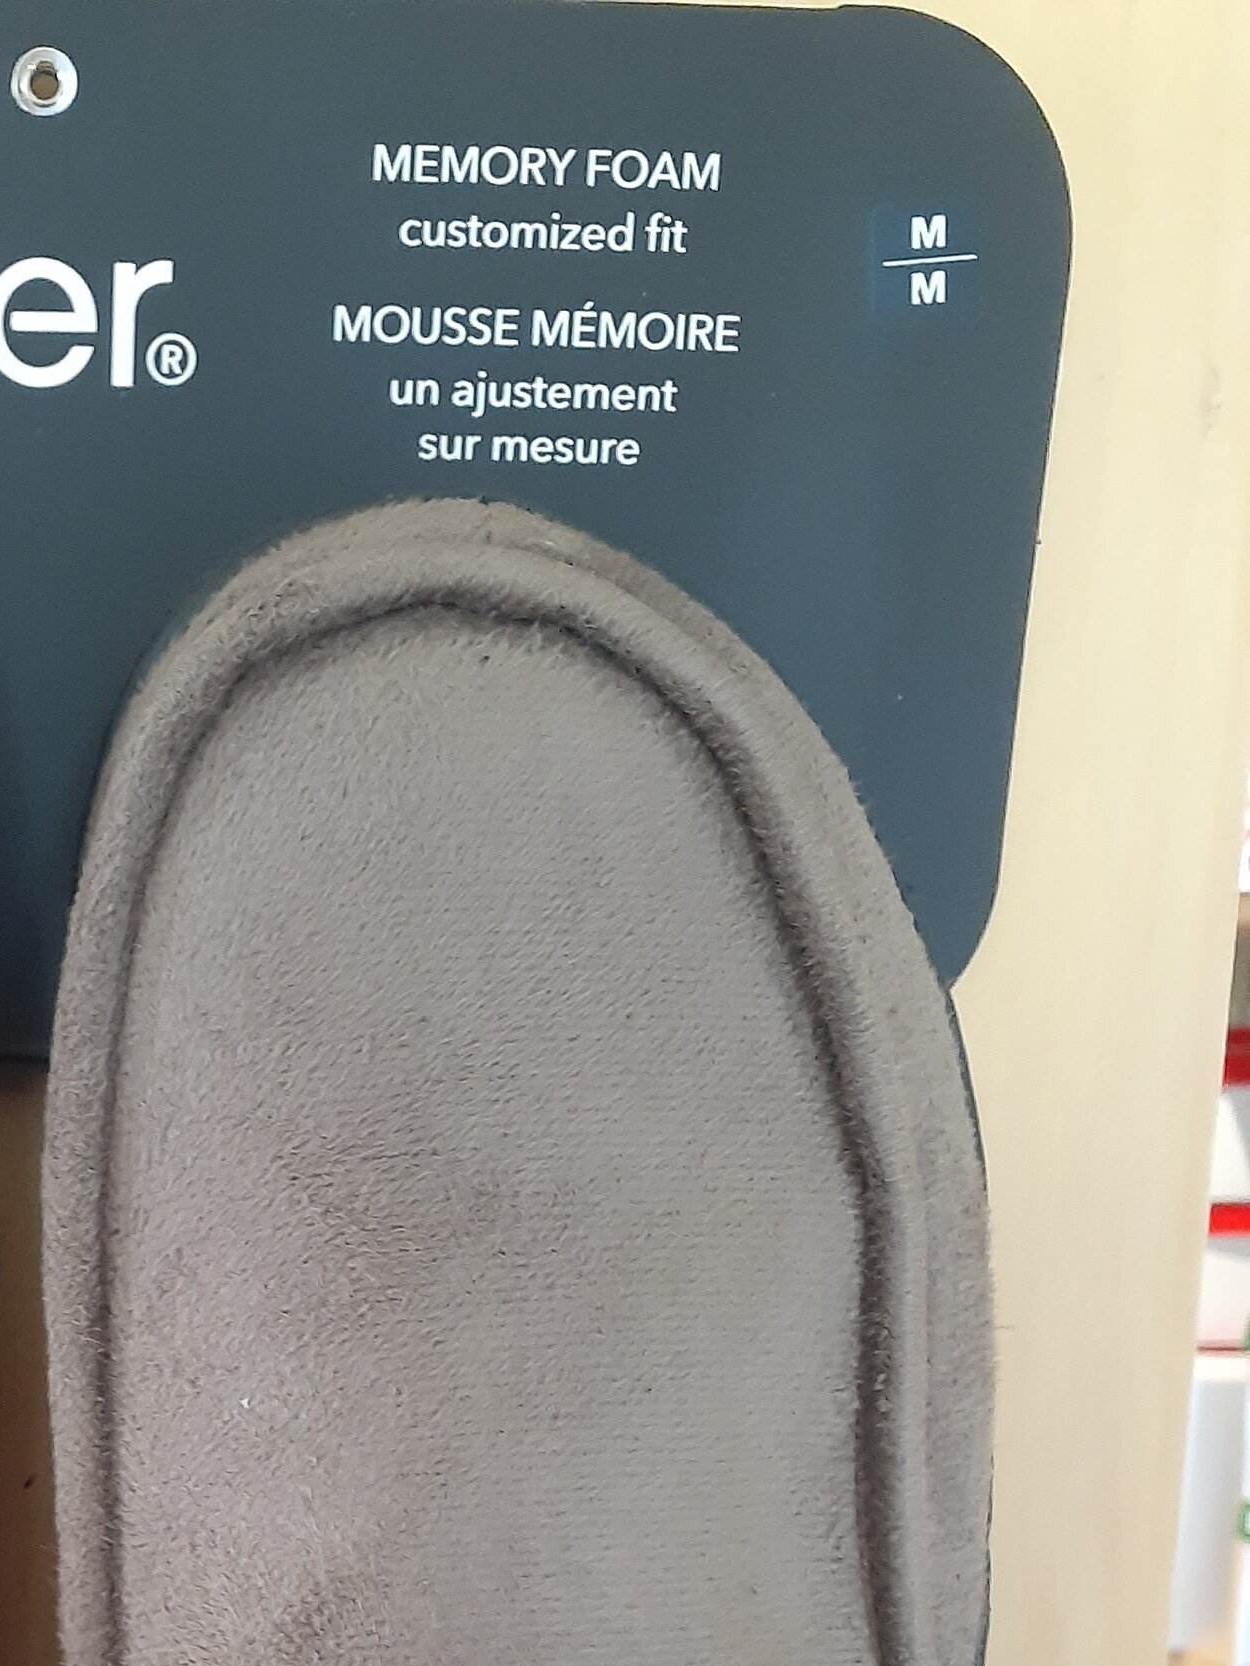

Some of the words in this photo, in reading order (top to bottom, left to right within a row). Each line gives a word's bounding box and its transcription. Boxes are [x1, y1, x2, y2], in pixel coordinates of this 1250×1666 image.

[372, 143, 576, 187] MEMORY
[585, 148, 722, 192] FOAM
[398, 211, 636, 253] customized
[643, 211, 690, 255] fit
[909, 213, 948, 251] M
[909, 269, 947, 307] M
[333, 304, 521, 348] MOUSSE
[530, 300, 742, 353] MÉMOIRE
[388, 378, 441, 407] un
[450, 370, 680, 420] ajustement
[416, 432, 483, 462] sur
[490, 434, 642, 467] mesure
